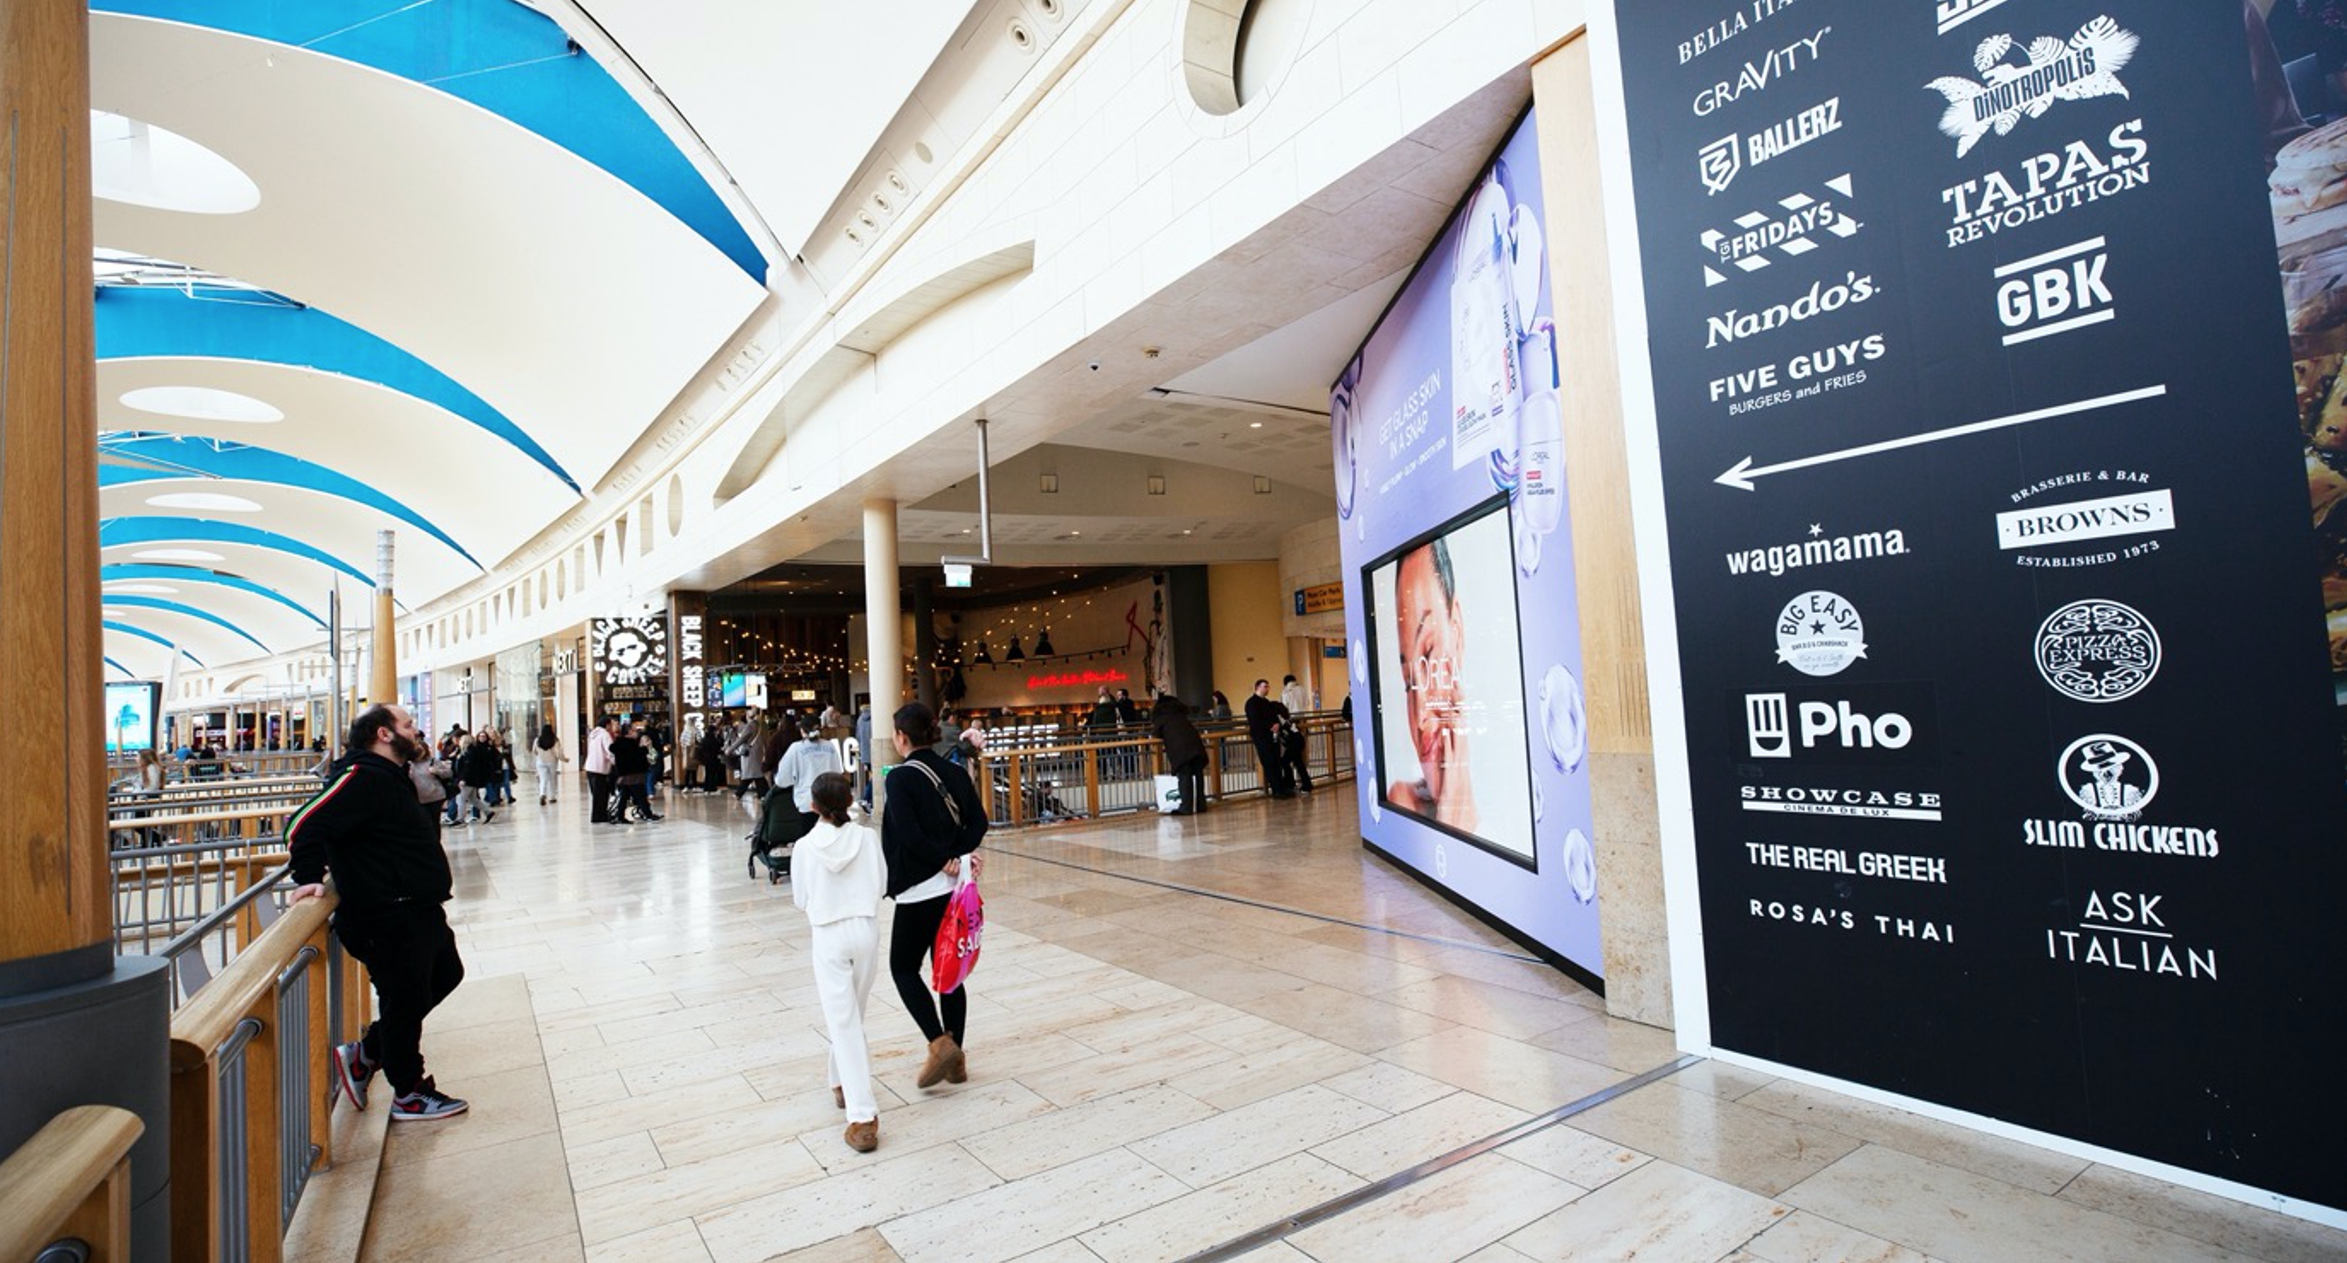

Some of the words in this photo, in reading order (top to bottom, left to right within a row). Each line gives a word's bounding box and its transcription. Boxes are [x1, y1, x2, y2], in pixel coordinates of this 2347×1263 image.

[1677, 11, 1749, 65] BELLA
[1748, 96, 1843, 167] BALLERZ
[1941, 117, 2149, 225] TAPAS
[1945, 162, 2151, 248] REVOLUTION
[1719, 240, 1732, 265] TGI
[1731, 201, 1834, 260] FRIDAYS
[1996, 253, 2114, 328] GBK
[1709, 364, 1779, 402] FIVE
[1788, 334, 1886, 380] GUYS
[1728, 389, 1793, 416] BURGERS
[1795, 381, 1822, 400] and
[1824, 369, 1868, 392] FRIES
[2011, 471, 2093, 504] BRASSERIE
[2097, 469, 2110, 481] &
[2116, 469, 2150, 484] BAR
[2017, 502, 2152, 538] BROWNS
[1726, 528, 1906, 577] wagamama
[2016, 551, 2118, 568] ESTABLISHED
[2123, 539, 2161, 559] 1973
[1780, 604, 1806, 636] BIG
[1810, 594, 1859, 632] EASY
[592, 616, 621, 658] BLACK
[621, 616, 665, 641] SHEEP
[681, 615, 702, 660] BLACK
[2049, 644, 2147, 663] EXPRESS
[2065, 634, 2127, 650] PIZZA
[605, 655, 665, 684] COFFEE
[682, 665, 704, 708] SHEEP
[1800, 700, 1913, 750] Pho
[1740, 785, 1941, 808] SHOWCASE
[1783, 803, 1835, 814] CINEMA
[1839, 806, 1858, 815] DE
[1862, 809, 1890, 817] LUX
[2023, 818, 2086, 849] SLIM
[2093, 822, 2219, 859] CHICKENS
[1745, 842, 1791, 868] THE
[1792, 845, 1857, 875] REAL
[1858, 851, 1948, 884] GREEK
[1749, 898, 1855, 930] ROSA'S
[1874, 915, 1954, 943] THAI
[2084, 889, 2166, 928] ASK
[2047, 928, 2217, 982] ITALIAN
